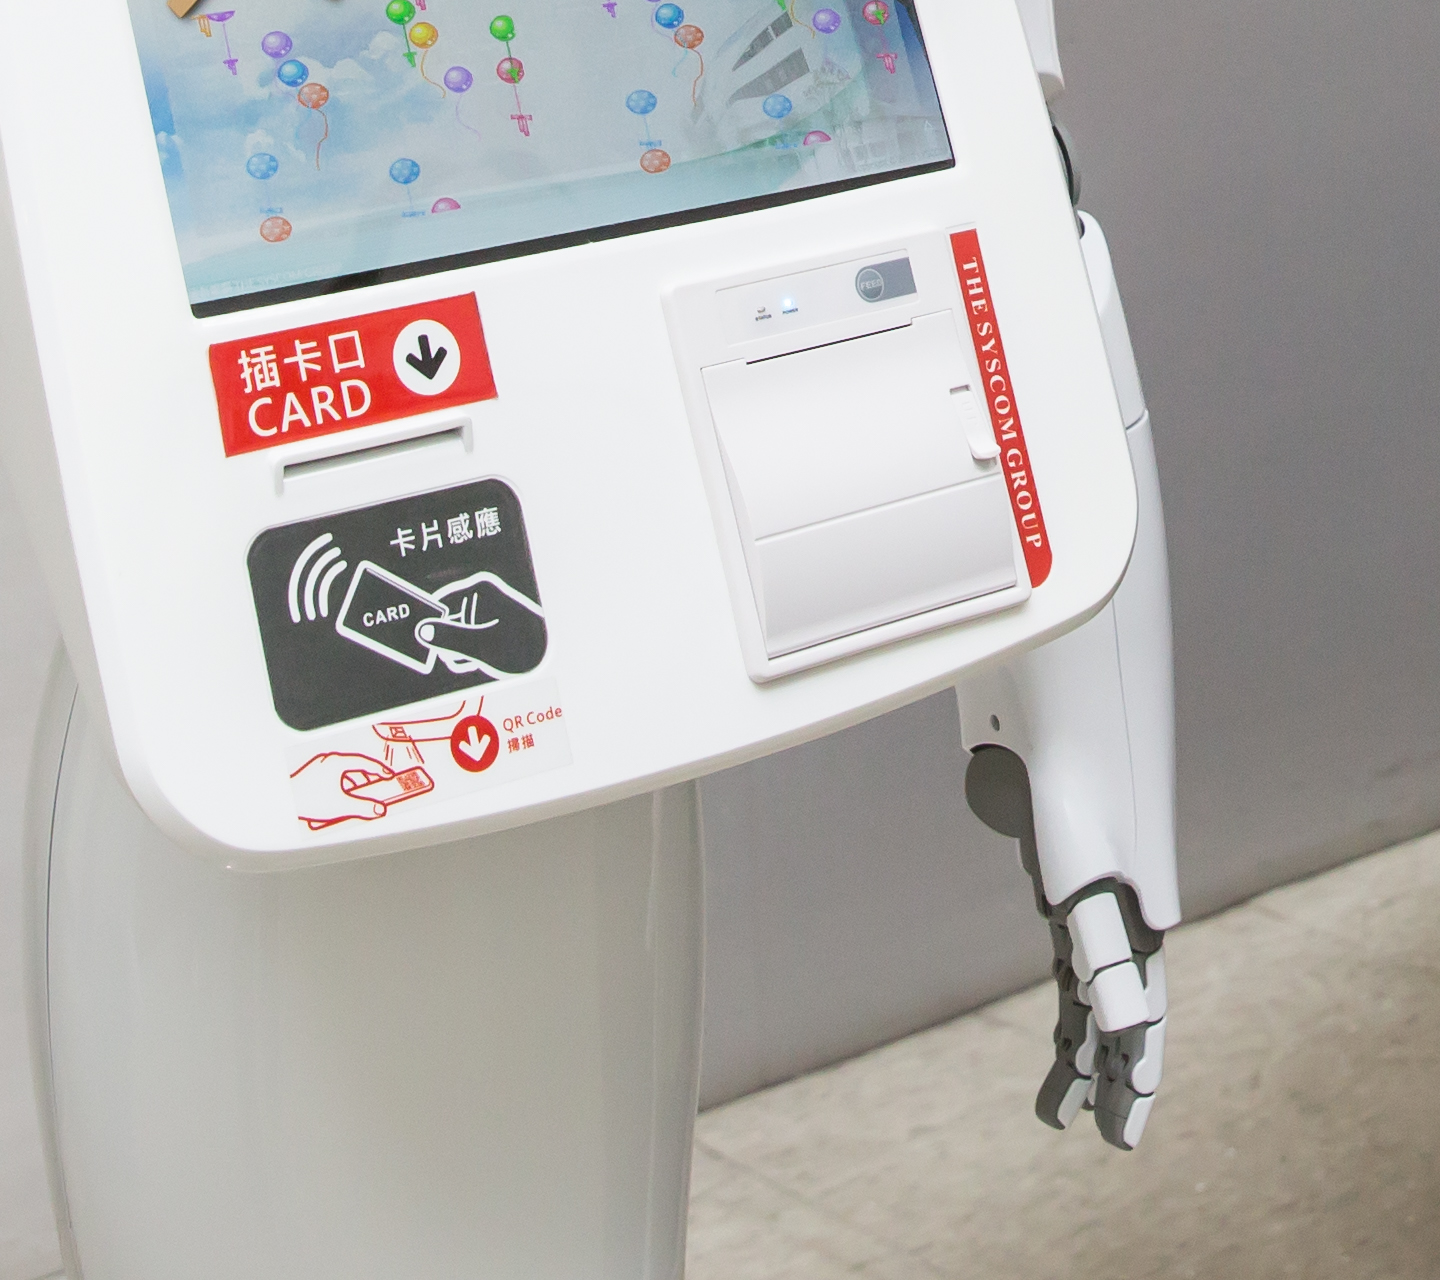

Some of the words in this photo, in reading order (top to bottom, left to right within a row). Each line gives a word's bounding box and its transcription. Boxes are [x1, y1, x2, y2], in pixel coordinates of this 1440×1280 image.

[237, 330, 366, 394] 插卡口
[248, 378, 372, 438] CARD
[962, 257, 988, 315] THE
[976, 321, 1018, 442] SYSCOM
[1006, 448, 1043, 549] GROUP
[389, 507, 502, 558] 卡片感應
[362, 603, 410, 627] CARD
[503, 715, 524, 733] QR
[526, 706, 562, 724] Code
